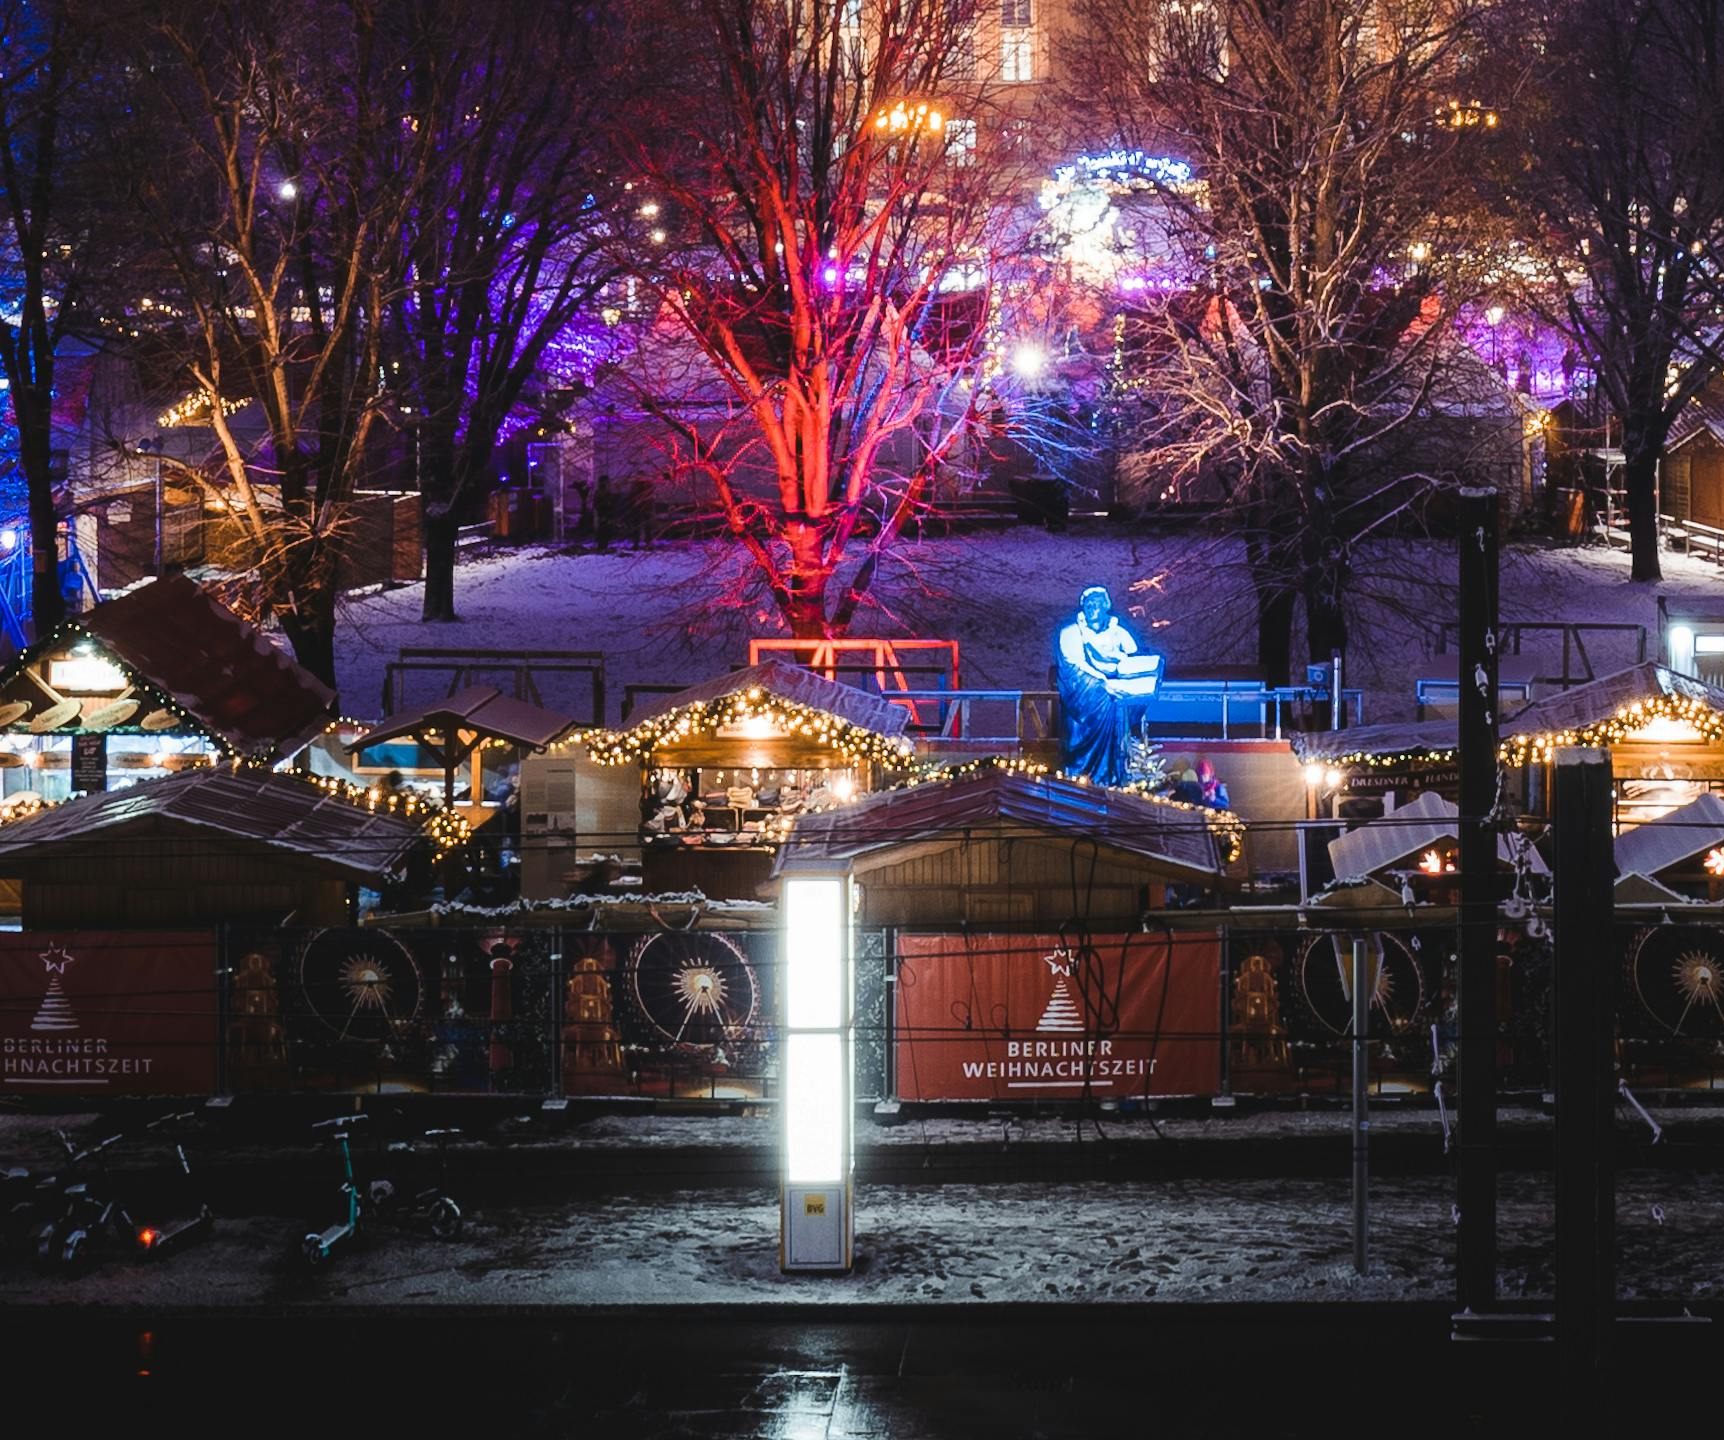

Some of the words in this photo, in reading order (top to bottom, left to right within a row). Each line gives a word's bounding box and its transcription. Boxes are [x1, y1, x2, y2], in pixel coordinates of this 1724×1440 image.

[1351, 776, 1408, 787] DRESDNER
[4, 1038, 109, 1054] BERLINER
[1007, 1040, 1113, 1058] BERLINER
[962, 1059, 1157, 1079] WEIHNACHTSZEIT
